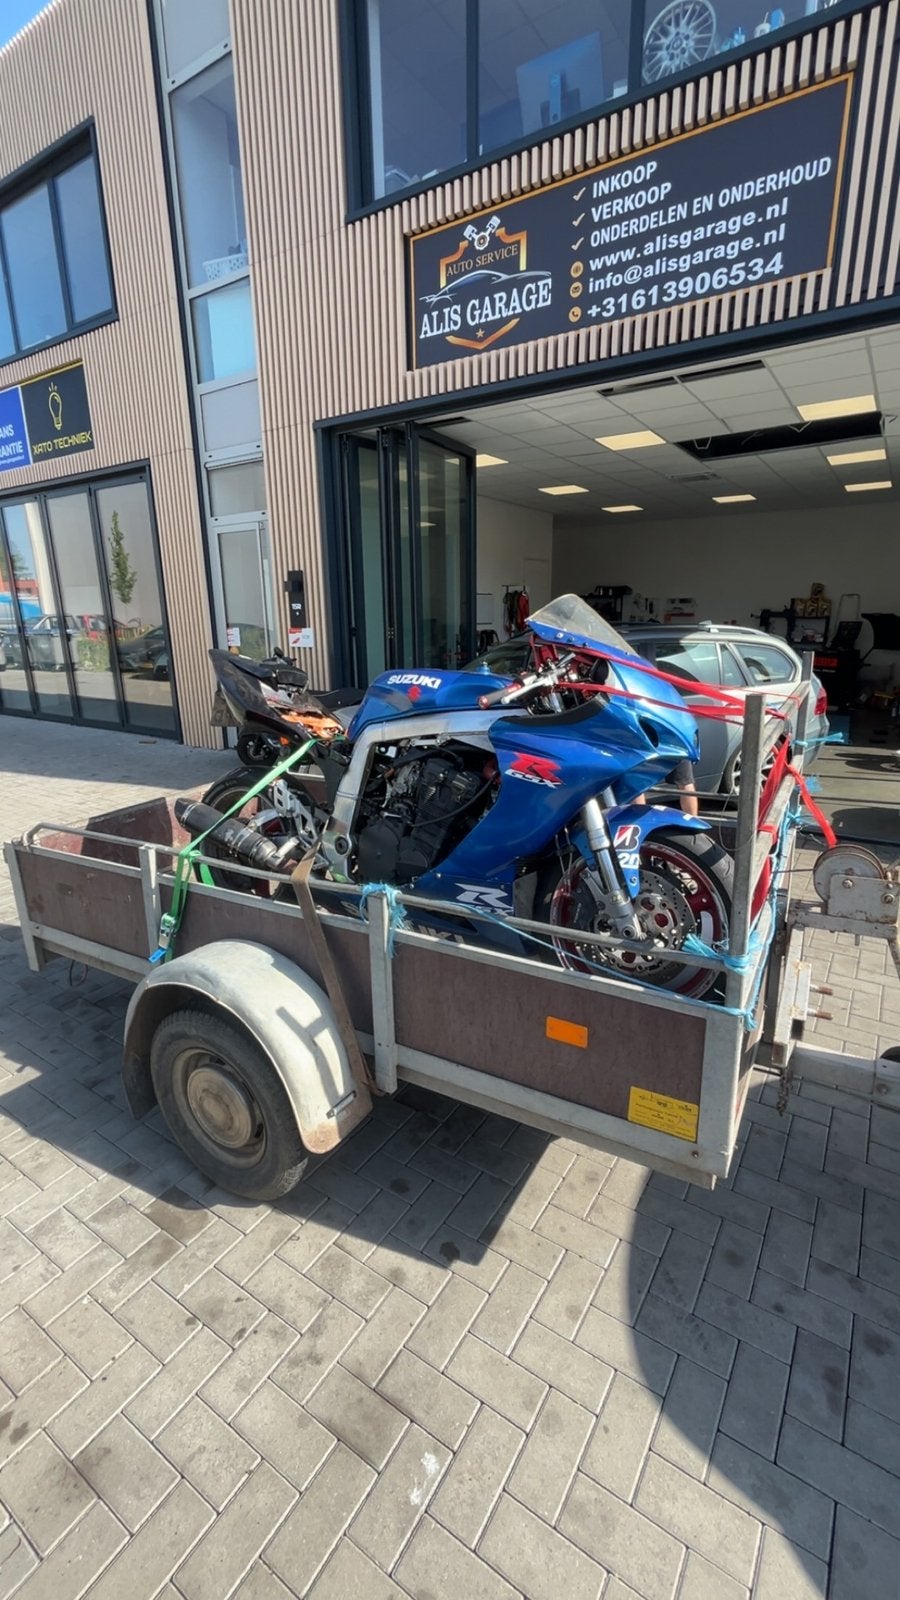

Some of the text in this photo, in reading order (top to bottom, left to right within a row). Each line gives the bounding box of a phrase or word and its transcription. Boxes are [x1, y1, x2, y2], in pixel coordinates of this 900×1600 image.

[590, 156, 832, 248] ONDERDELEN EN ONDERHOUD
[591, 182, 672, 223] VERKOOP
[592, 161, 657, 199] INKOOP
[588, 223, 786, 294] info@alisgarage.nl
[589, 197, 789, 272] www.alisgarage.nl
[446, 244, 519, 277] AUTO SERVICE
[587, 252, 784, 318] +31613906534
[419, 278, 552, 339] ALIS GARAGE
[32, 430, 92, 456] XATO TECHNIEK
[387, 674, 442, 690] SUZUKI
